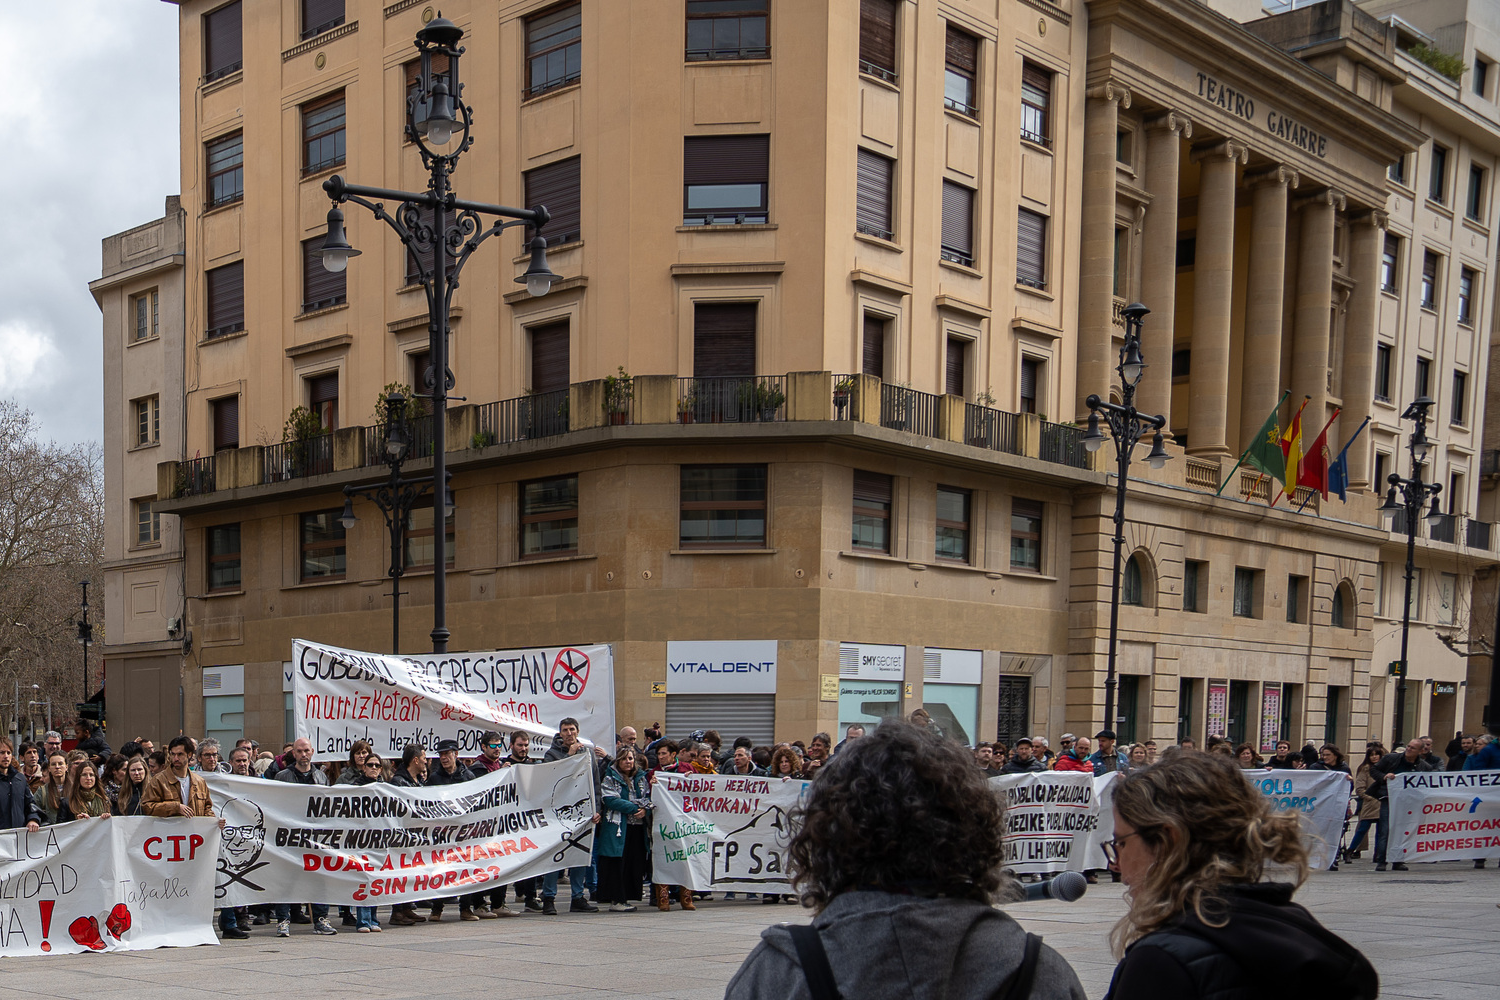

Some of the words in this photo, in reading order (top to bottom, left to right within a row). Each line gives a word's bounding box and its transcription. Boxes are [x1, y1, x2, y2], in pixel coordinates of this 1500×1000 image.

[1196, 72, 1255, 120] TEATRO
[1267, 111, 1327, 159] GAYARRE
[669, 662, 774, 673] VITALDENT
[304, 689, 425, 722] murrizketak
[667, 777, 716, 793] LANBIDE
[724, 778, 770, 794] HEZIKETA
[1057, 785, 1091, 804] CALIDAD
[306, 796, 407, 819] NAFARROAKO
[411, 796, 462, 819] LANBIDE
[682, 796, 760, 817] BORROKAN!
[1422, 802, 1466, 815] ORDU
[275, 827, 341, 850] BERTZE
[348, 826, 430, 850] MURRIZKETA
[430, 824, 453, 847] BAT
[498, 808, 549, 834] DIGUTE
[1417, 818, 1500, 835] ERRATIOAK
[143, 833, 204, 862] CIP
[302, 853, 375, 872] DUAL
[380, 854, 394, 871] A
[400, 850, 425, 869] LA
[432, 836, 539, 865] NAVARRA
[1028, 841, 1044, 860] LH
[711, 841, 739, 884] FP
[352, 876, 407, 901] ¿SIN
[413, 865, 501, 892] HORAS?
